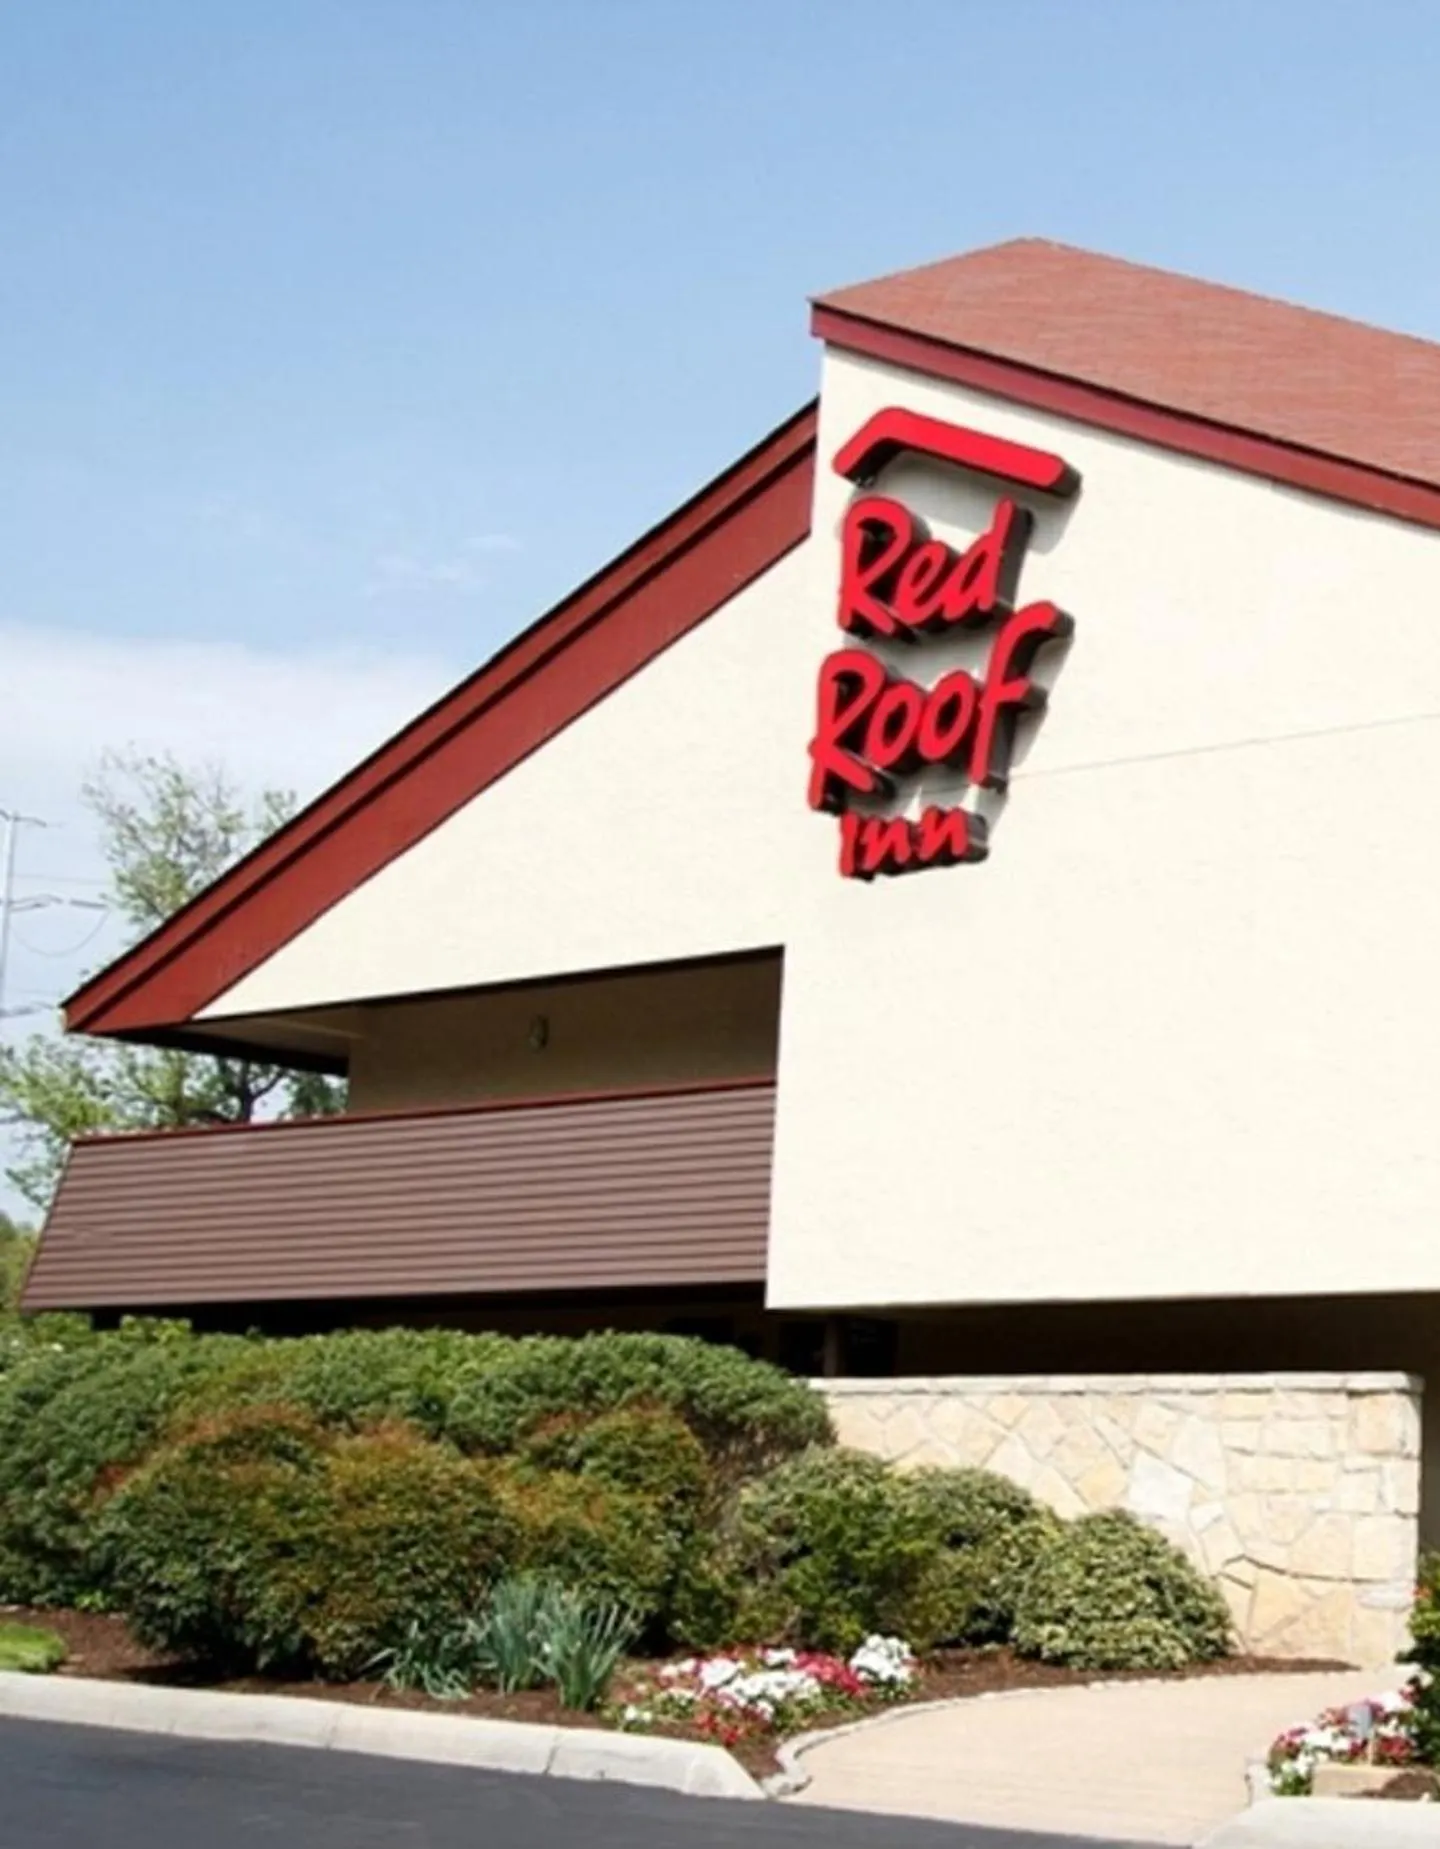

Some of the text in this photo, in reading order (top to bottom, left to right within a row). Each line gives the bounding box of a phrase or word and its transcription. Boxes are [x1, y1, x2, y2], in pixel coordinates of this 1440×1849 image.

[837, 496, 1015, 635] Red
[807, 600, 1057, 810] Roof
[839, 805, 969, 878] Inn
